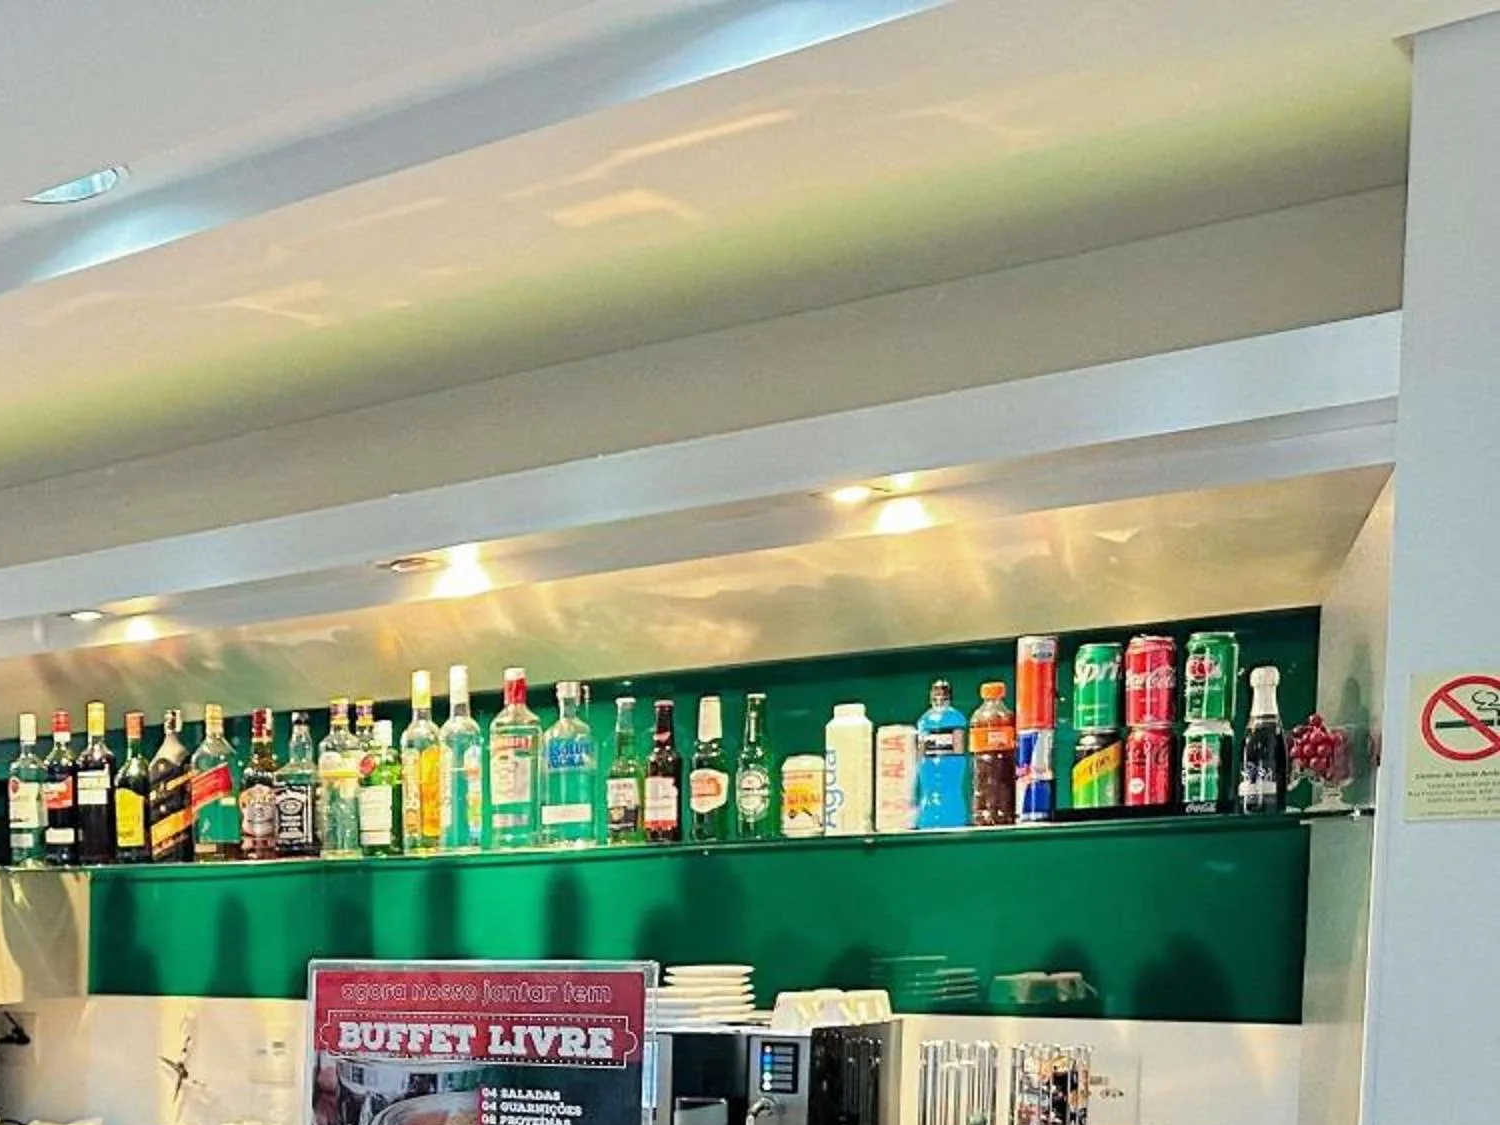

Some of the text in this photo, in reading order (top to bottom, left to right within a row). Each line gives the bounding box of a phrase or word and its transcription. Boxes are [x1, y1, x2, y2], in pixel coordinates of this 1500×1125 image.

[1074, 655, 1122, 686] Spri
[341, 980, 613, 1005] agora nosso jantar tem
[338, 1021, 614, 1059] BUFFET LIVRE
[500, 1088, 561, 1101] SALADAS
[501, 1101, 583, 1117] GUARNIÇÕES
